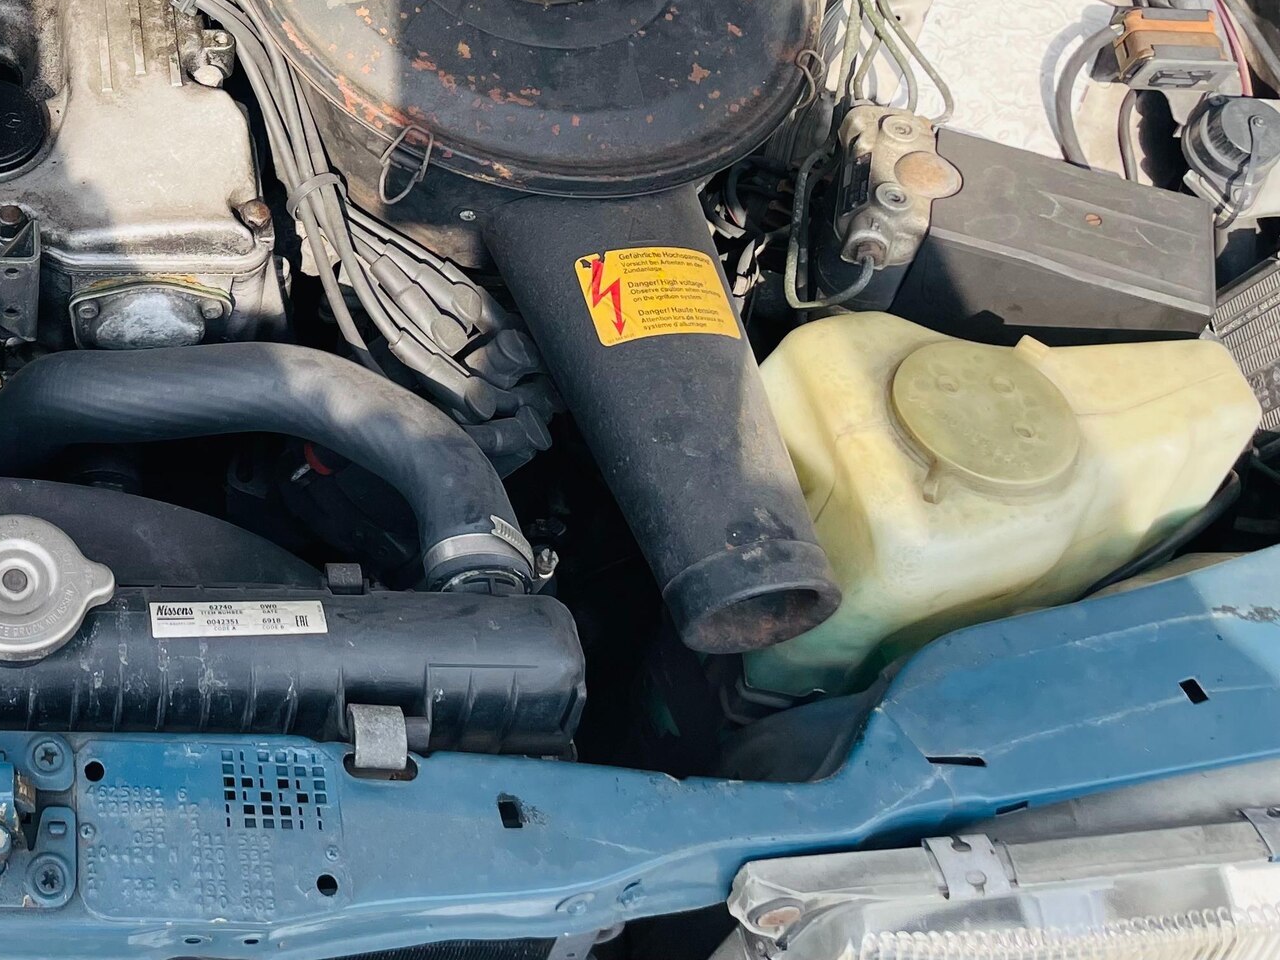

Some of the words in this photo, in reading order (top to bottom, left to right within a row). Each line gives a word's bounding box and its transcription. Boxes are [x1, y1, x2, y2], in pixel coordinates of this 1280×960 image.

[620, 260, 648, 268] Vorsicht
[627, 279, 660, 289] Danger!
[660, 279, 678, 287] High
[630, 287, 659, 295] Observe
[655, 294, 679, 302] ignition
[637, 308, 669, 317] Danger!
[641, 315, 673, 324] Attention
[156, 605, 194, 616] Nissens
